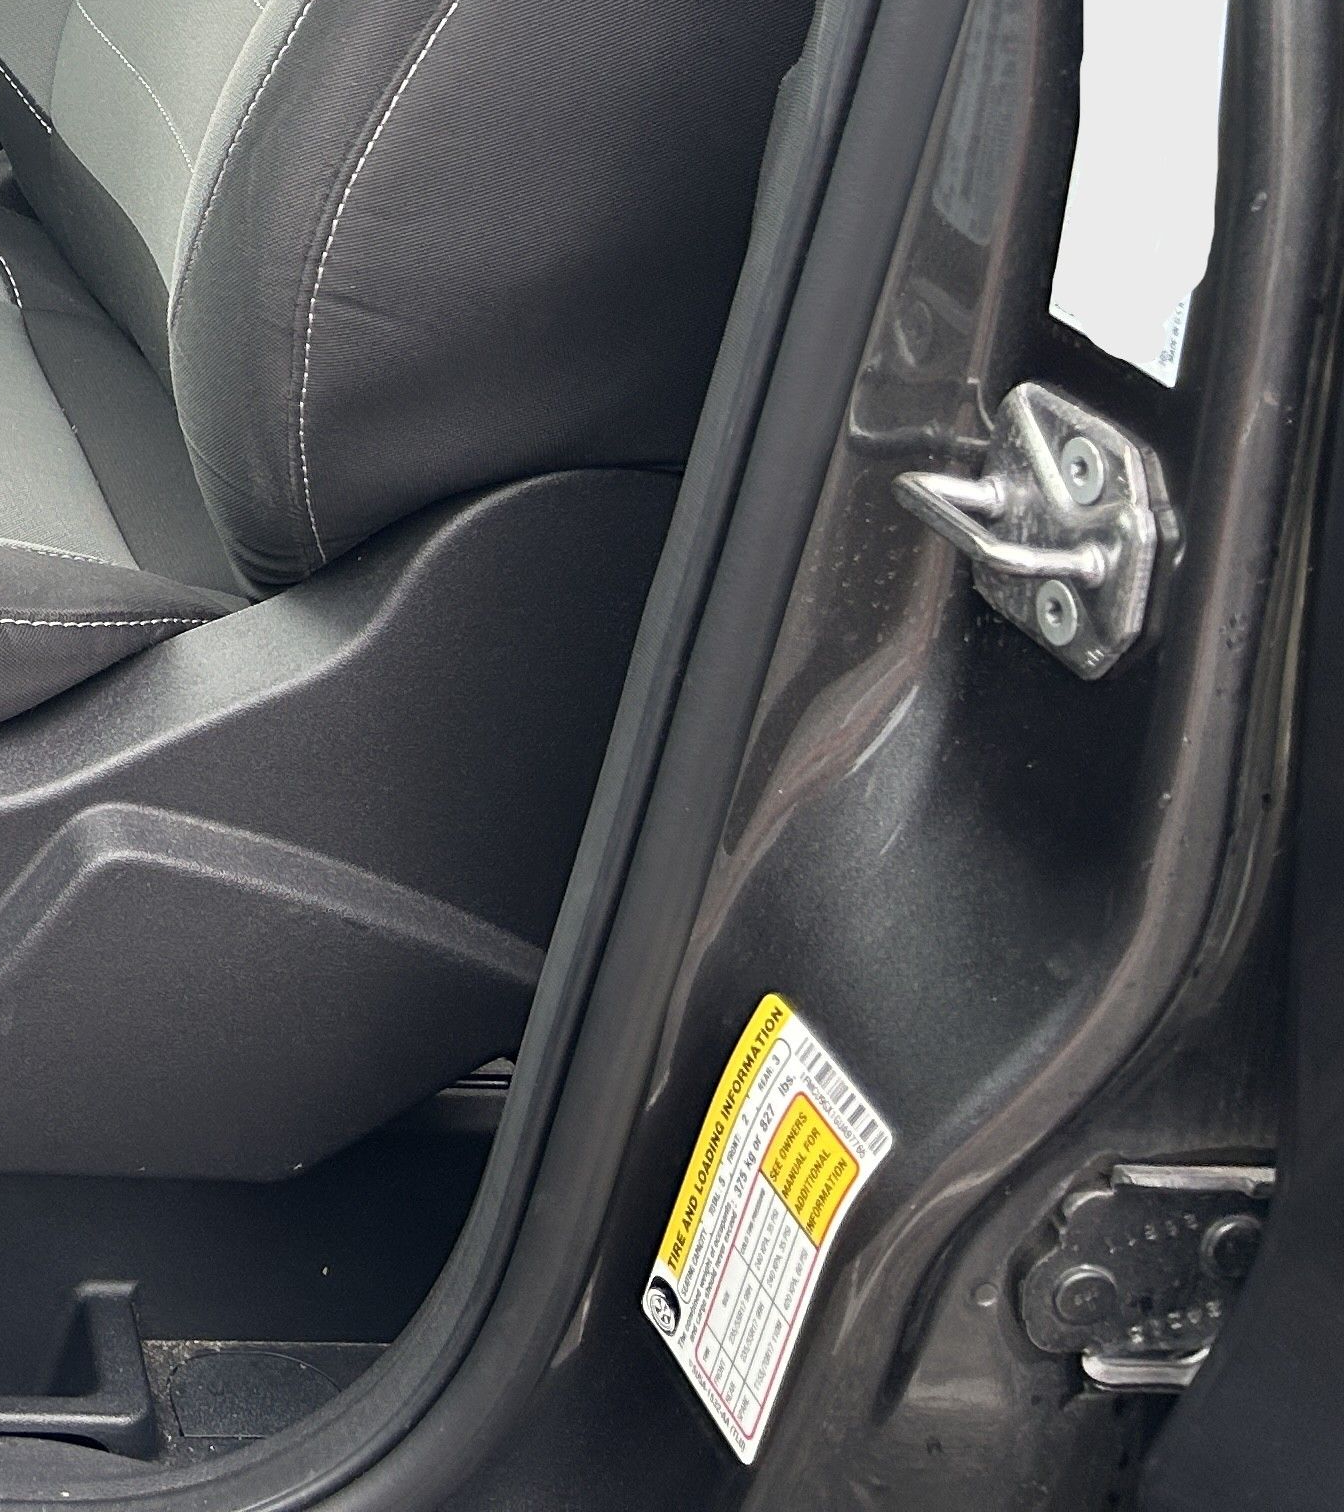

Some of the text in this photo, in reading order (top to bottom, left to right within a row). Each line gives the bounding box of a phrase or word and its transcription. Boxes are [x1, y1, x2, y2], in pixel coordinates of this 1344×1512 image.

[667, 1005, 783, 1270] TIRE AND LOADING INFORMATION
[733, 1074, 795, 1197] 375 kg or 827 lbs.
[769, 1110, 807, 1183] SEE OWNERS
[781, 1126, 820, 1199] MANUAL FOR
[681, 1263, 694, 1296] SEATING
[691, 1227, 707, 1266] CAPACITY
[741, 1113, 749, 1125] 2
[771, 1053, 780, 1065] 3
[794, 1147, 830, 1214] ADDITIONAL
[805, 1157, 847, 1235] INFORMATION
[677, 1201, 731, 1348] The combined weight of occupants
[689, 1209, 737, 1342] and cargo should never exceed
[713, 1358, 726, 1386] FRONT
[725, 1381, 735, 1403] REAR
[737, 1395, 749, 1421] SPARE
